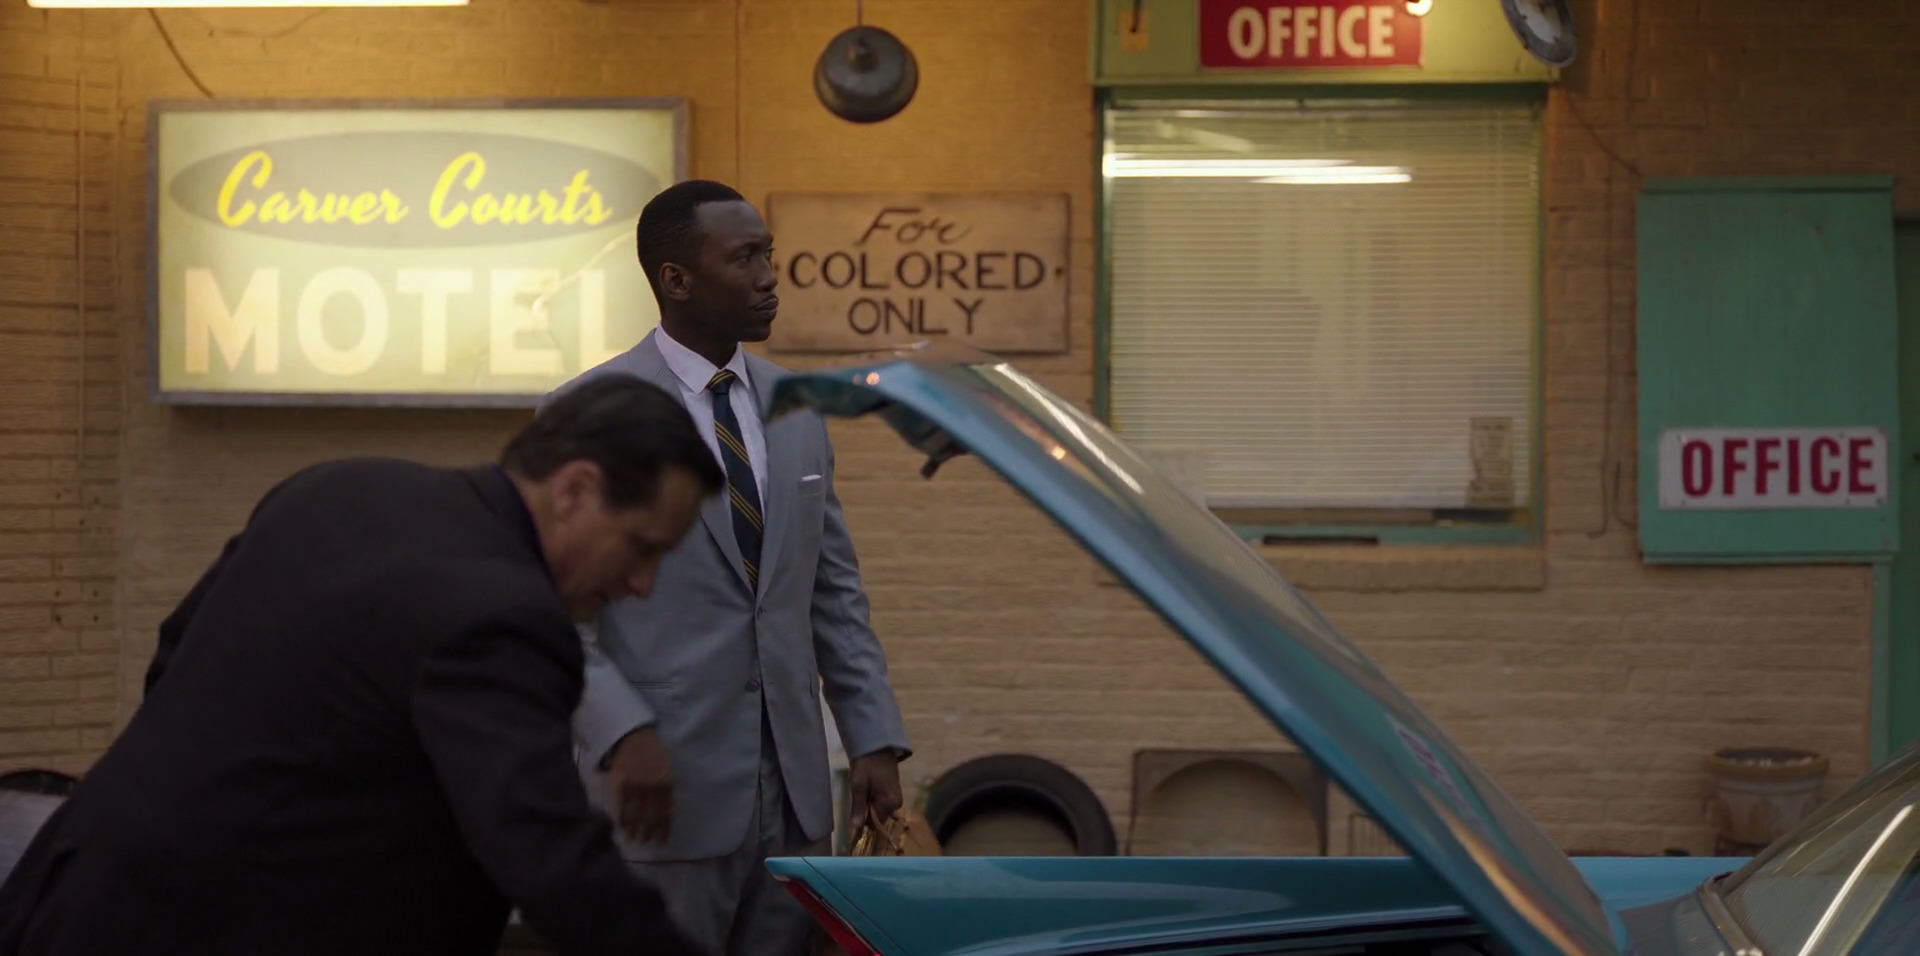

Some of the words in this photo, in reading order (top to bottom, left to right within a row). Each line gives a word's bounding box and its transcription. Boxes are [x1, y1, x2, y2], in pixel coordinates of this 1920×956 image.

[1229, 7, 1395, 58] OFFICE
[217, 151, 409, 227] Carver
[429, 152, 613, 229] Courts
[854, 207, 972, 246] For
[788, 251, 1045, 290] COLORED
[184, 267, 630, 376] MOTEL
[848, 297, 983, 335] ONLY
[1682, 437, 1876, 497] OFFICE
